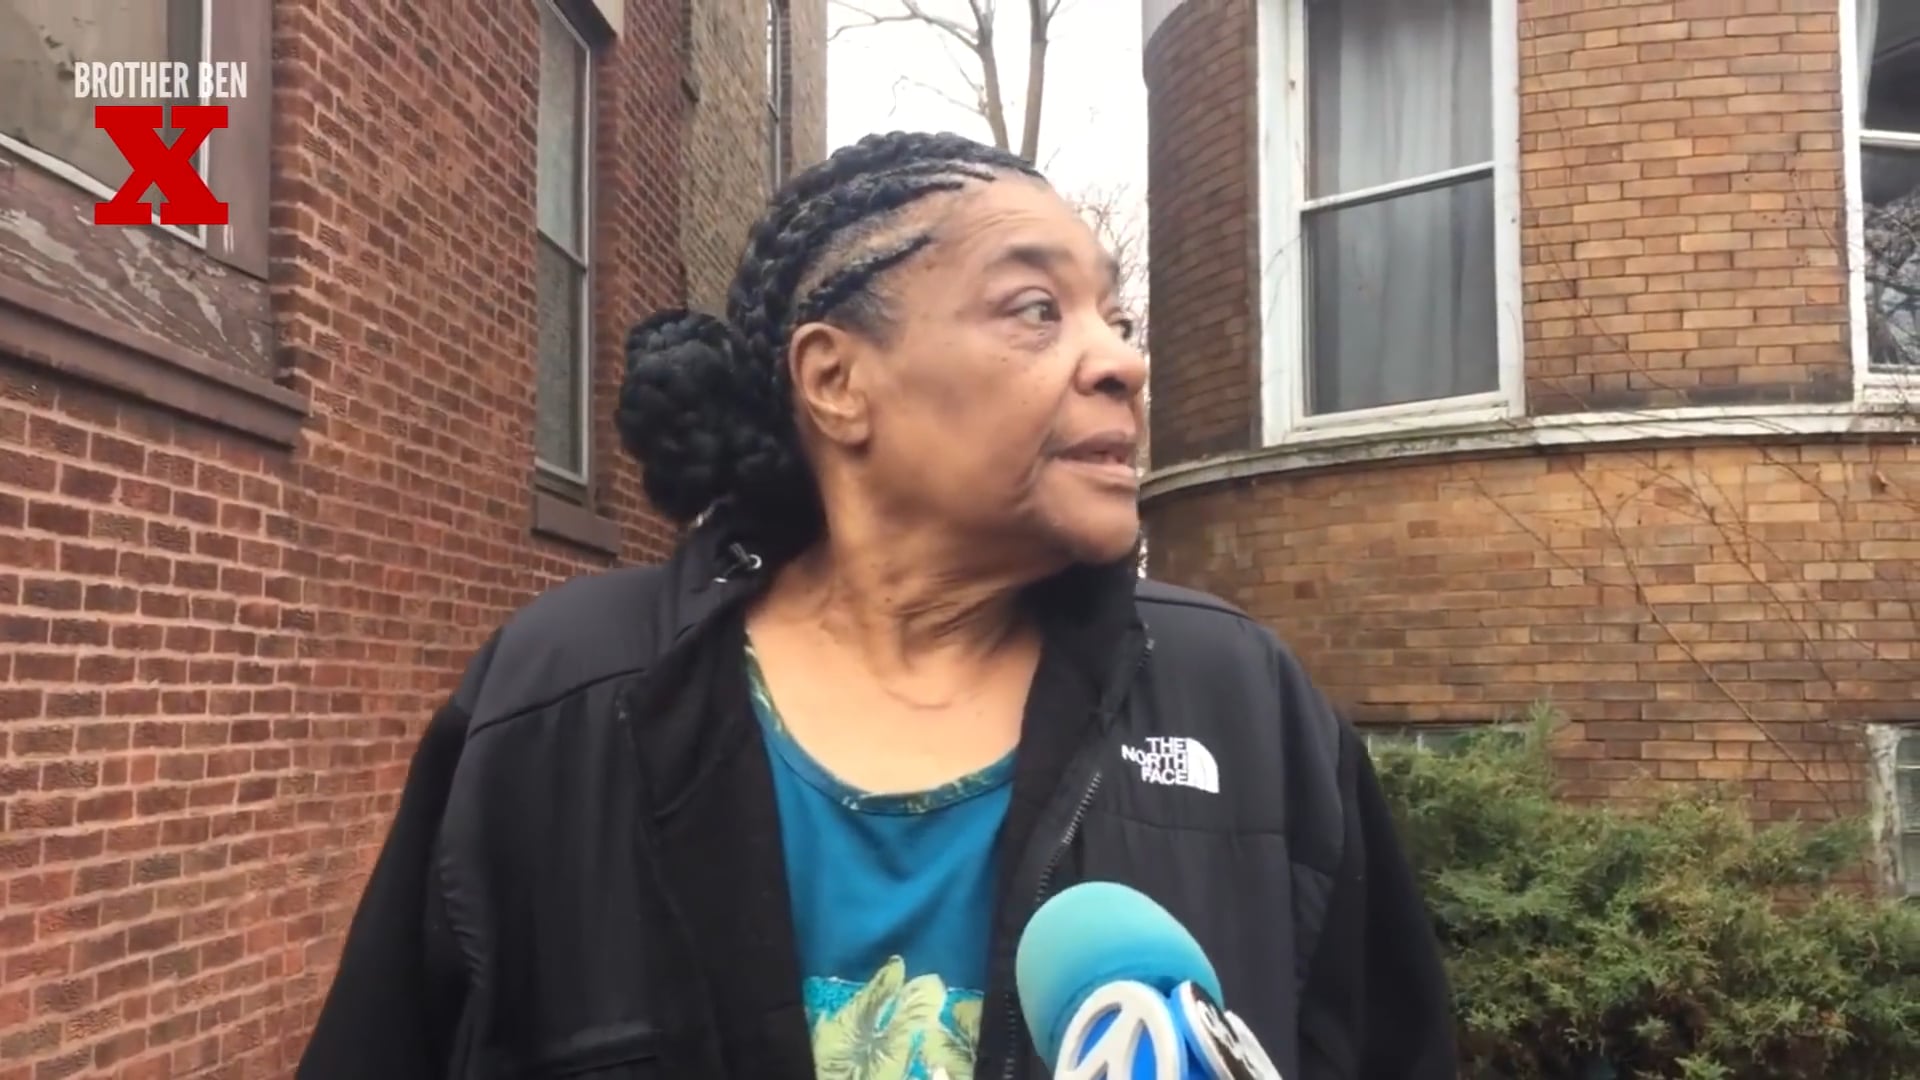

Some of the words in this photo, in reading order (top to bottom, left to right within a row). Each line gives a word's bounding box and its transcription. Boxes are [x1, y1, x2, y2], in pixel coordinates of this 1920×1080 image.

[1145, 736, 1187, 754] THE
[1121, 744, 1188, 770] NORTH
[1141, 765, 1188, 785] FACE
